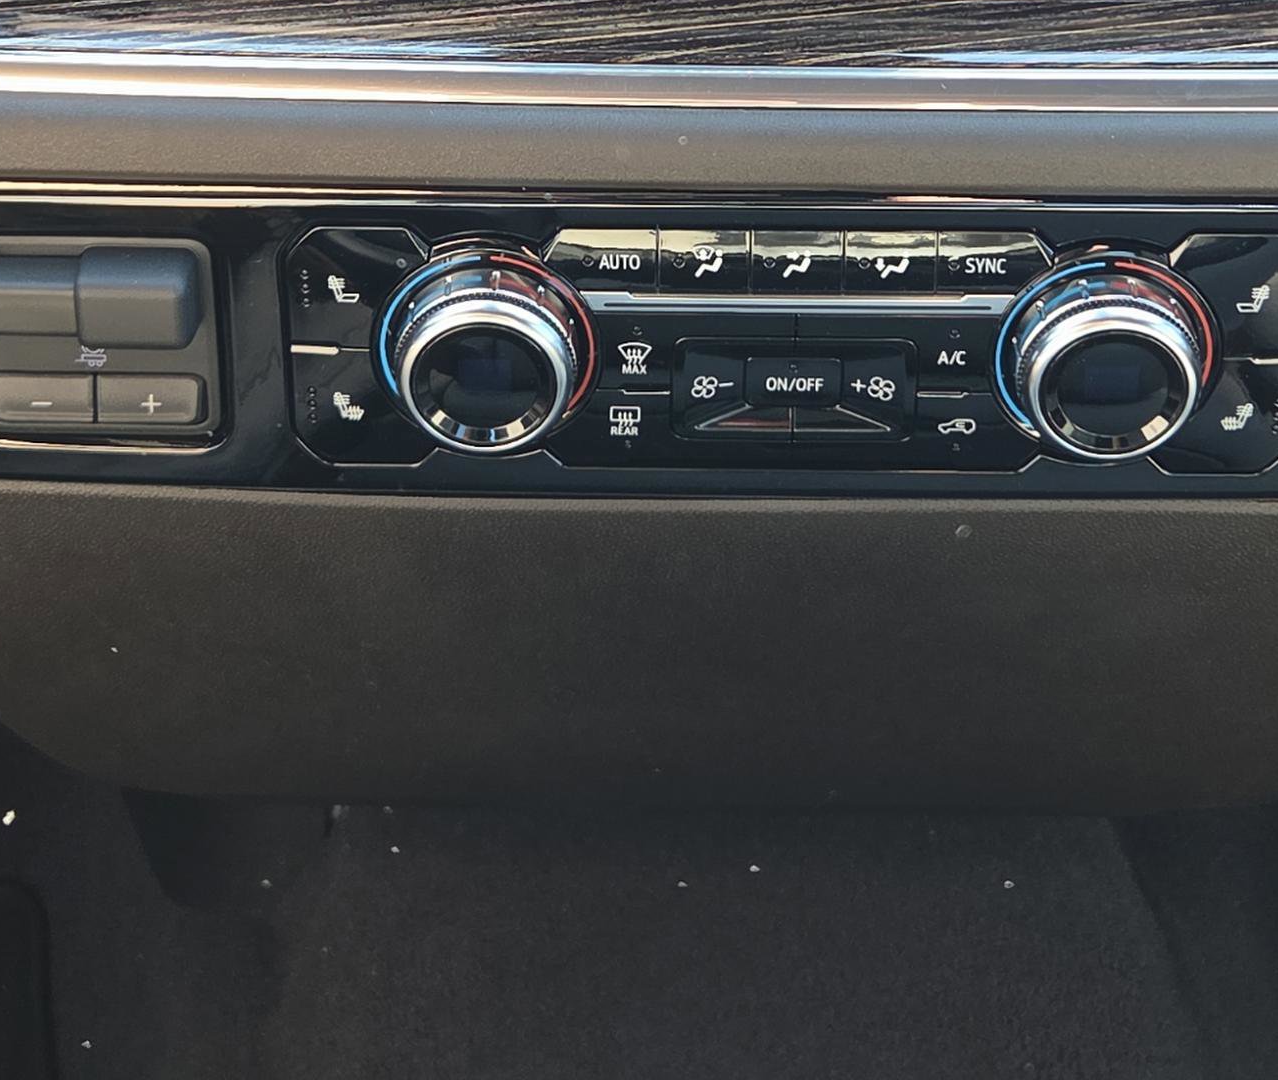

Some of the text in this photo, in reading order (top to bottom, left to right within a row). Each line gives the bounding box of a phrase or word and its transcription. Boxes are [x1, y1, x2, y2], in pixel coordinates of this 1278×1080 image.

[598, 253, 642, 271] AUTO
[964, 257, 1008, 275] SYNC
[936, 350, 967, 366] A/C
[621, 363, 648, 375] MAX
[765, 375, 826, 393] ON/OFF
[610, 425, 639, 437] REAR
